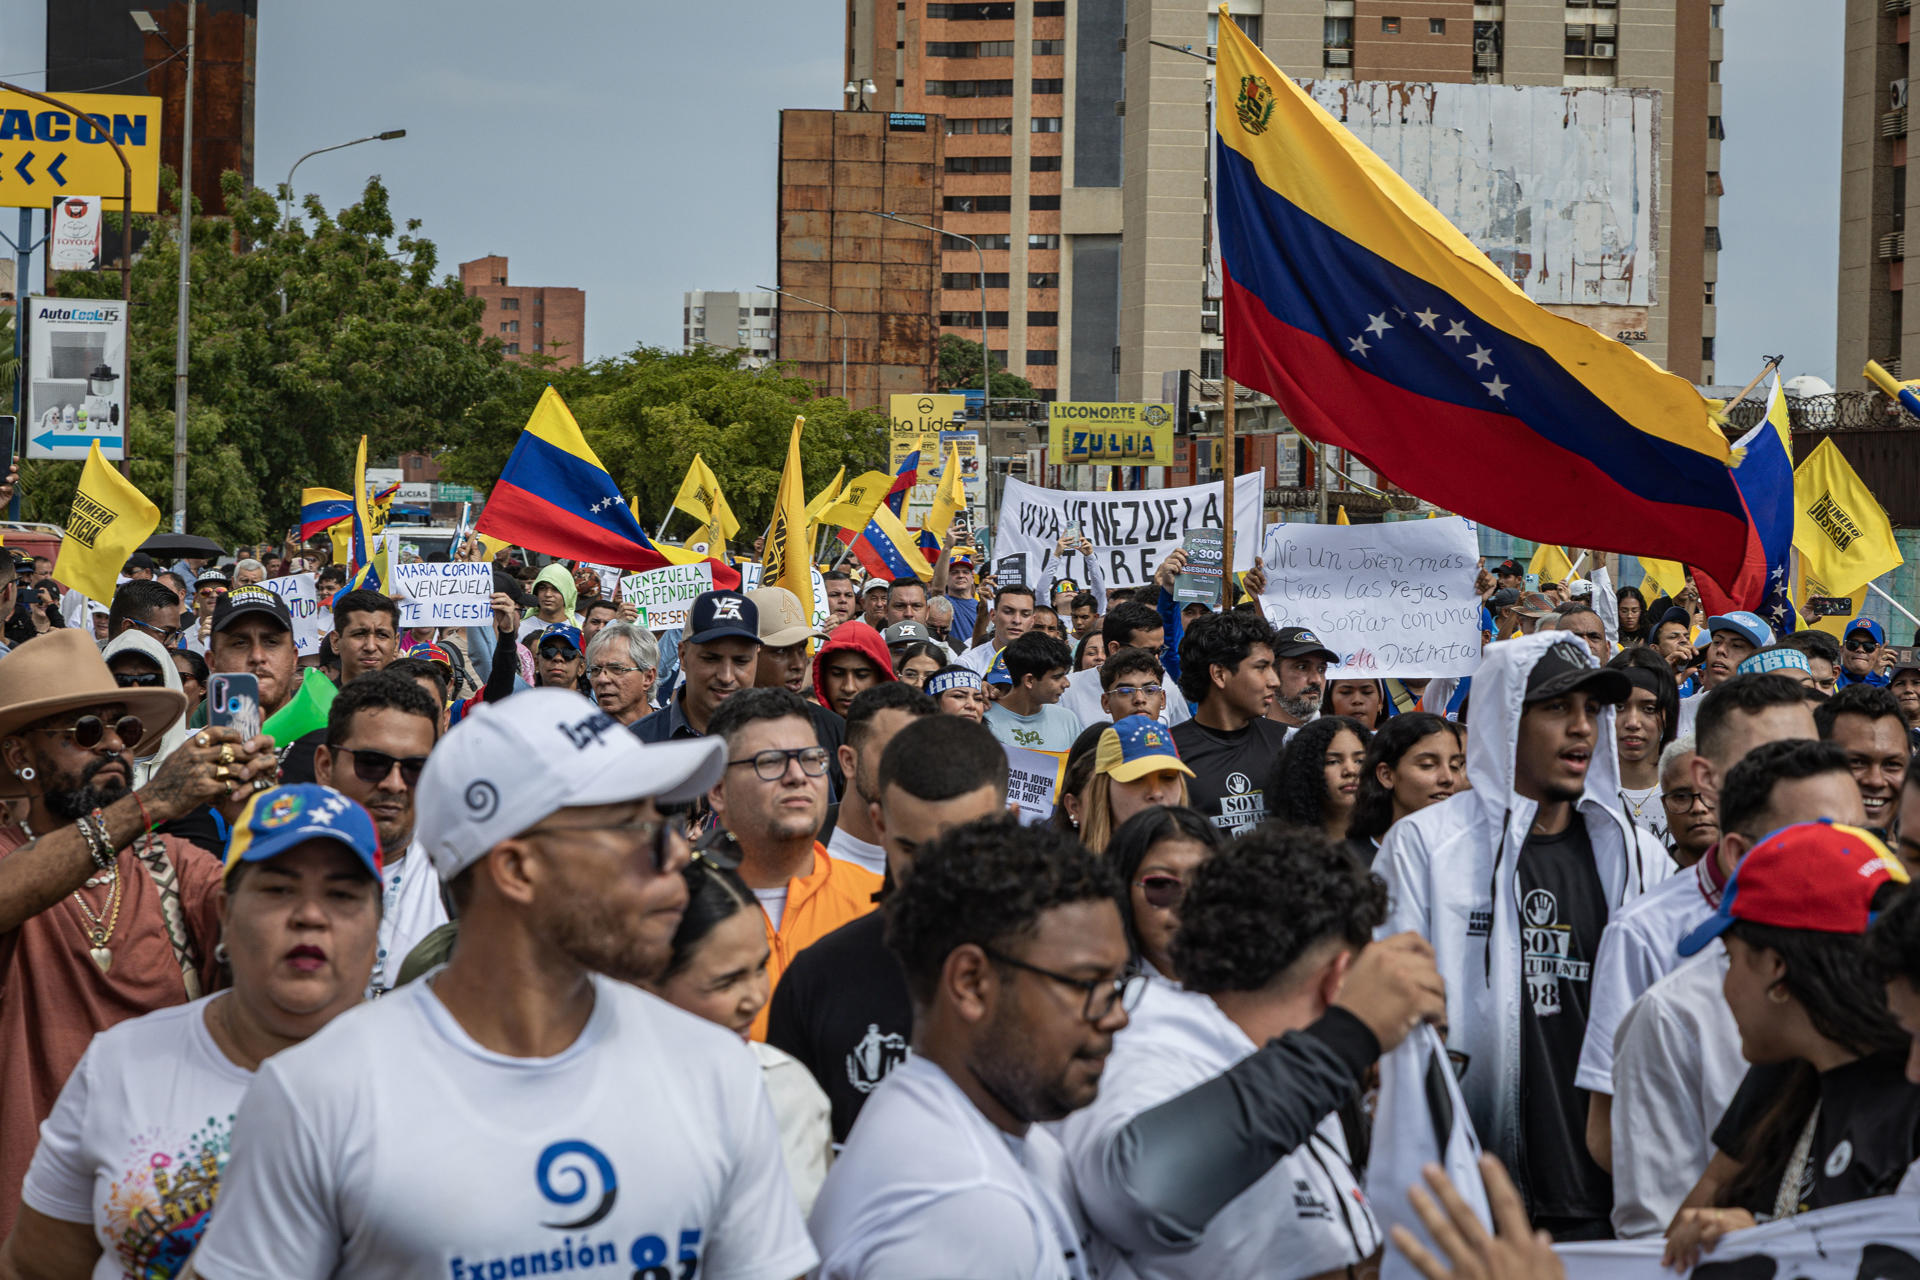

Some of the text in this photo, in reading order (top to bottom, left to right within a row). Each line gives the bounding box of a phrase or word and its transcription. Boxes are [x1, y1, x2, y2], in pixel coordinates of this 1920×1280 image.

[1617, 331, 1647, 341] 4235
[1054, 406, 1136, 419] LICONORTE
[893, 416, 958, 432] La Líde
[1071, 432, 1154, 454] ZULIA
[1020, 501, 1060, 542] VIVA
[1198, 549, 1223, 560] 300
[1267, 538, 1298, 571] Ni
[1348, 547, 1403, 573] Joven
[1409, 553, 1465, 573] más
[441, 563, 490, 577] CORINA
[622, 566, 704, 591] VENEZUELA
[404, 579, 491, 599] VENEZUELA
[624, 581, 712, 606] INDEPENDIENTE
[401, 603, 423, 620] TE
[648, 609, 689, 629] PRESEN
[1022, 782, 1047, 797] PUEDE
[1030, 773, 1054, 789] JOVEN
[1022, 792, 1040, 805] HOY:
[1226, 796, 1258, 813] SOY
[1522, 930, 1563, 955] SOY
[450, 1235, 618, 1280] Expansión
[630, 1226, 703, 1280] 85
